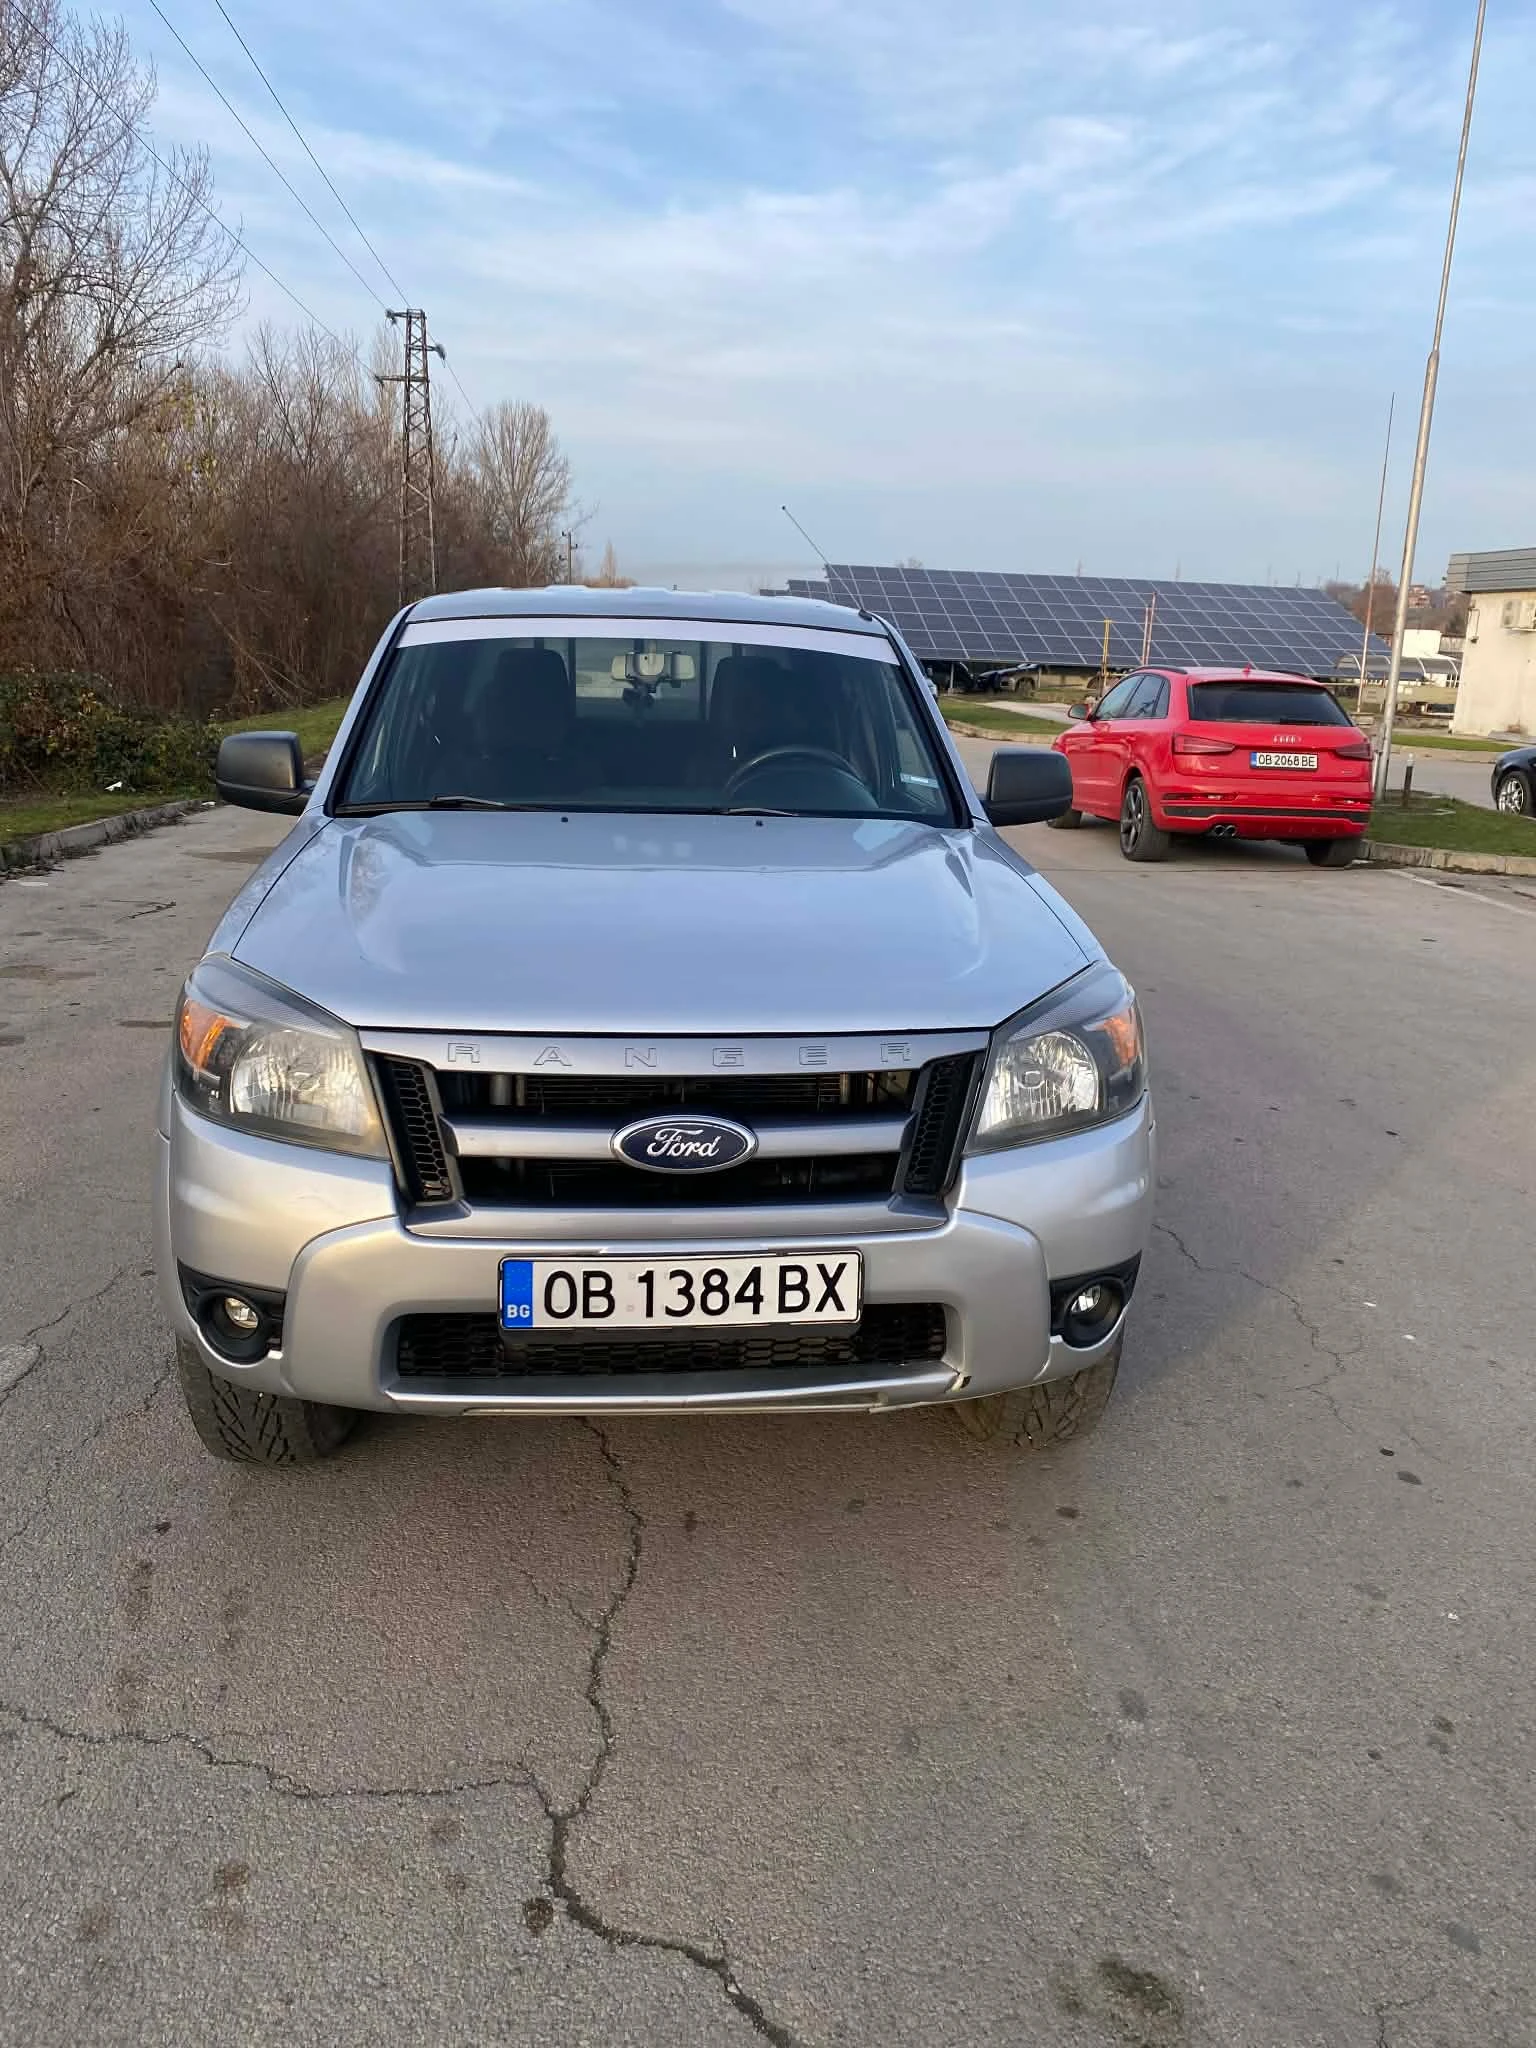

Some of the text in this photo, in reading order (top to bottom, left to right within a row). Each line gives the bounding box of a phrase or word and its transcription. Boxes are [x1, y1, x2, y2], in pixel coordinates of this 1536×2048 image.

[1258, 754, 1316, 767] OB 2068 BE
[447, 1041, 912, 1068] RANGER
[646, 1128, 722, 1157] Ford
[543, 1262, 848, 1319] OB 1384 BX
[507, 1304, 531, 1318] BG
